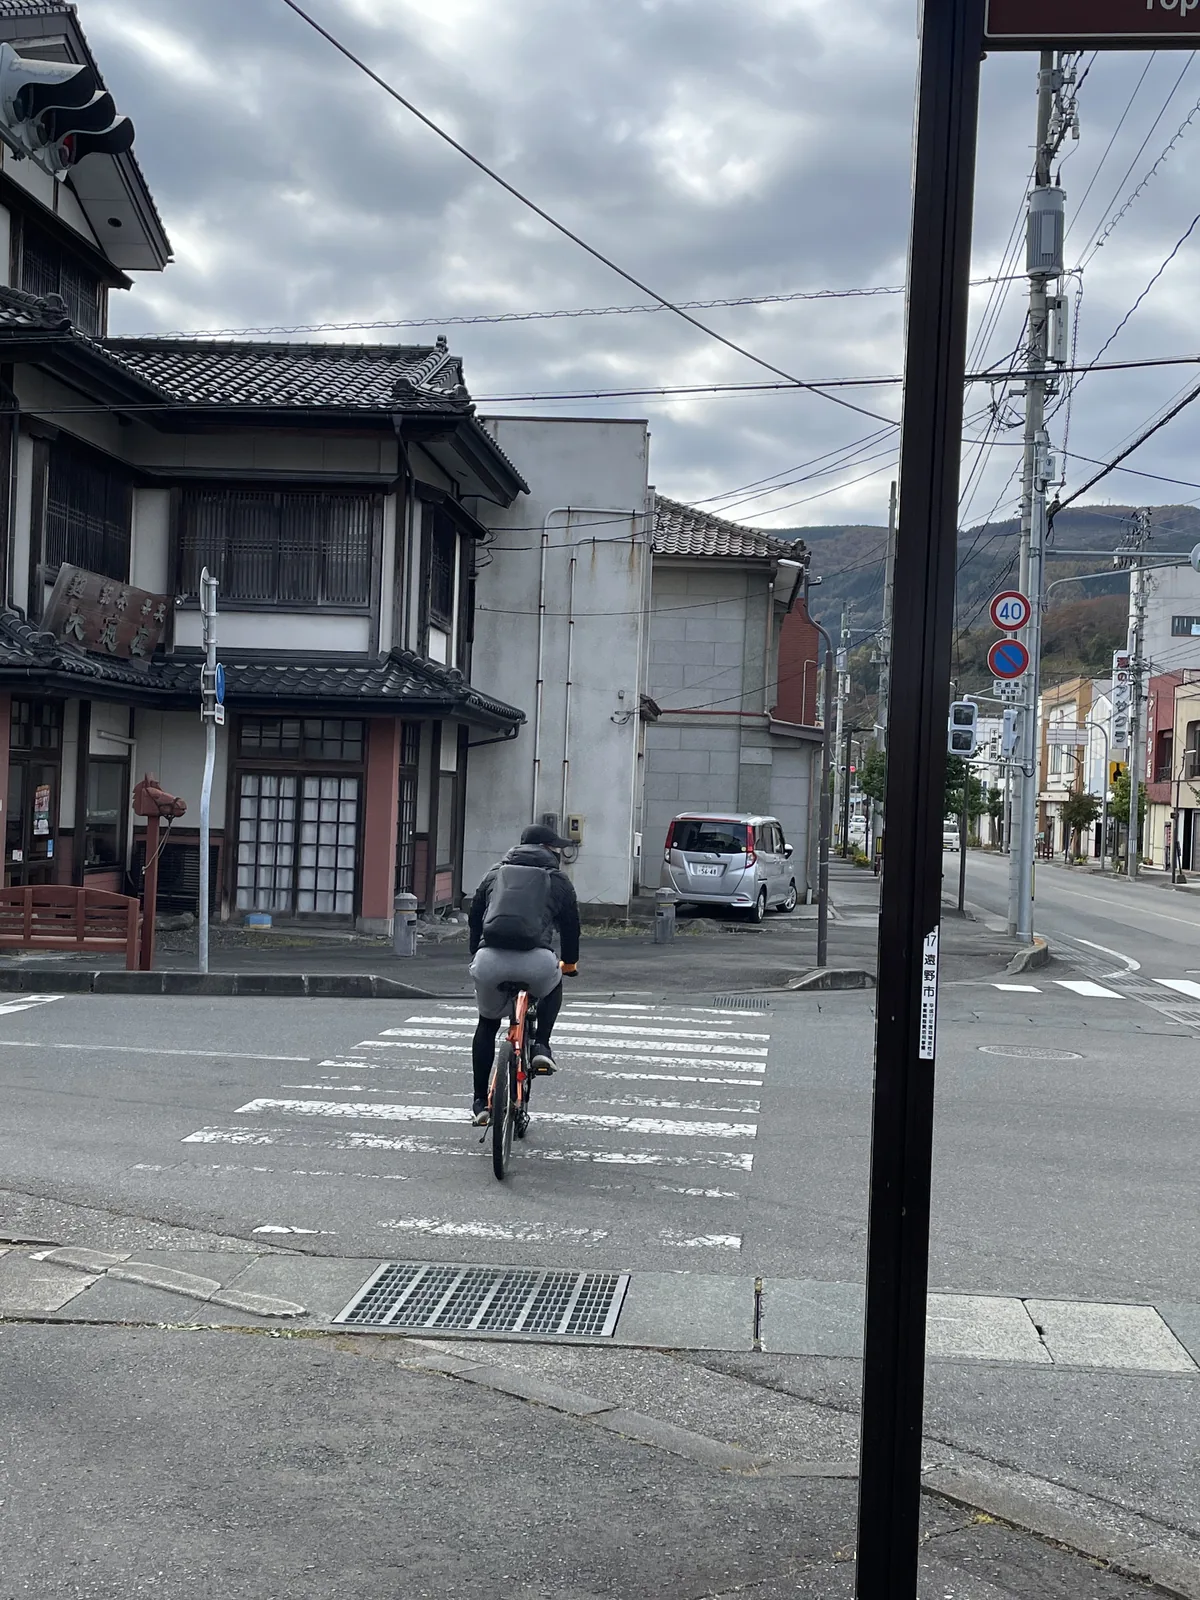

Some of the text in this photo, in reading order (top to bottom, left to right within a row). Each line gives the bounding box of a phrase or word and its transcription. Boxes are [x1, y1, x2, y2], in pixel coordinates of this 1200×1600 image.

[1000, 602, 1022, 620] 40
[923, 953, 936, 998] 遠野市
